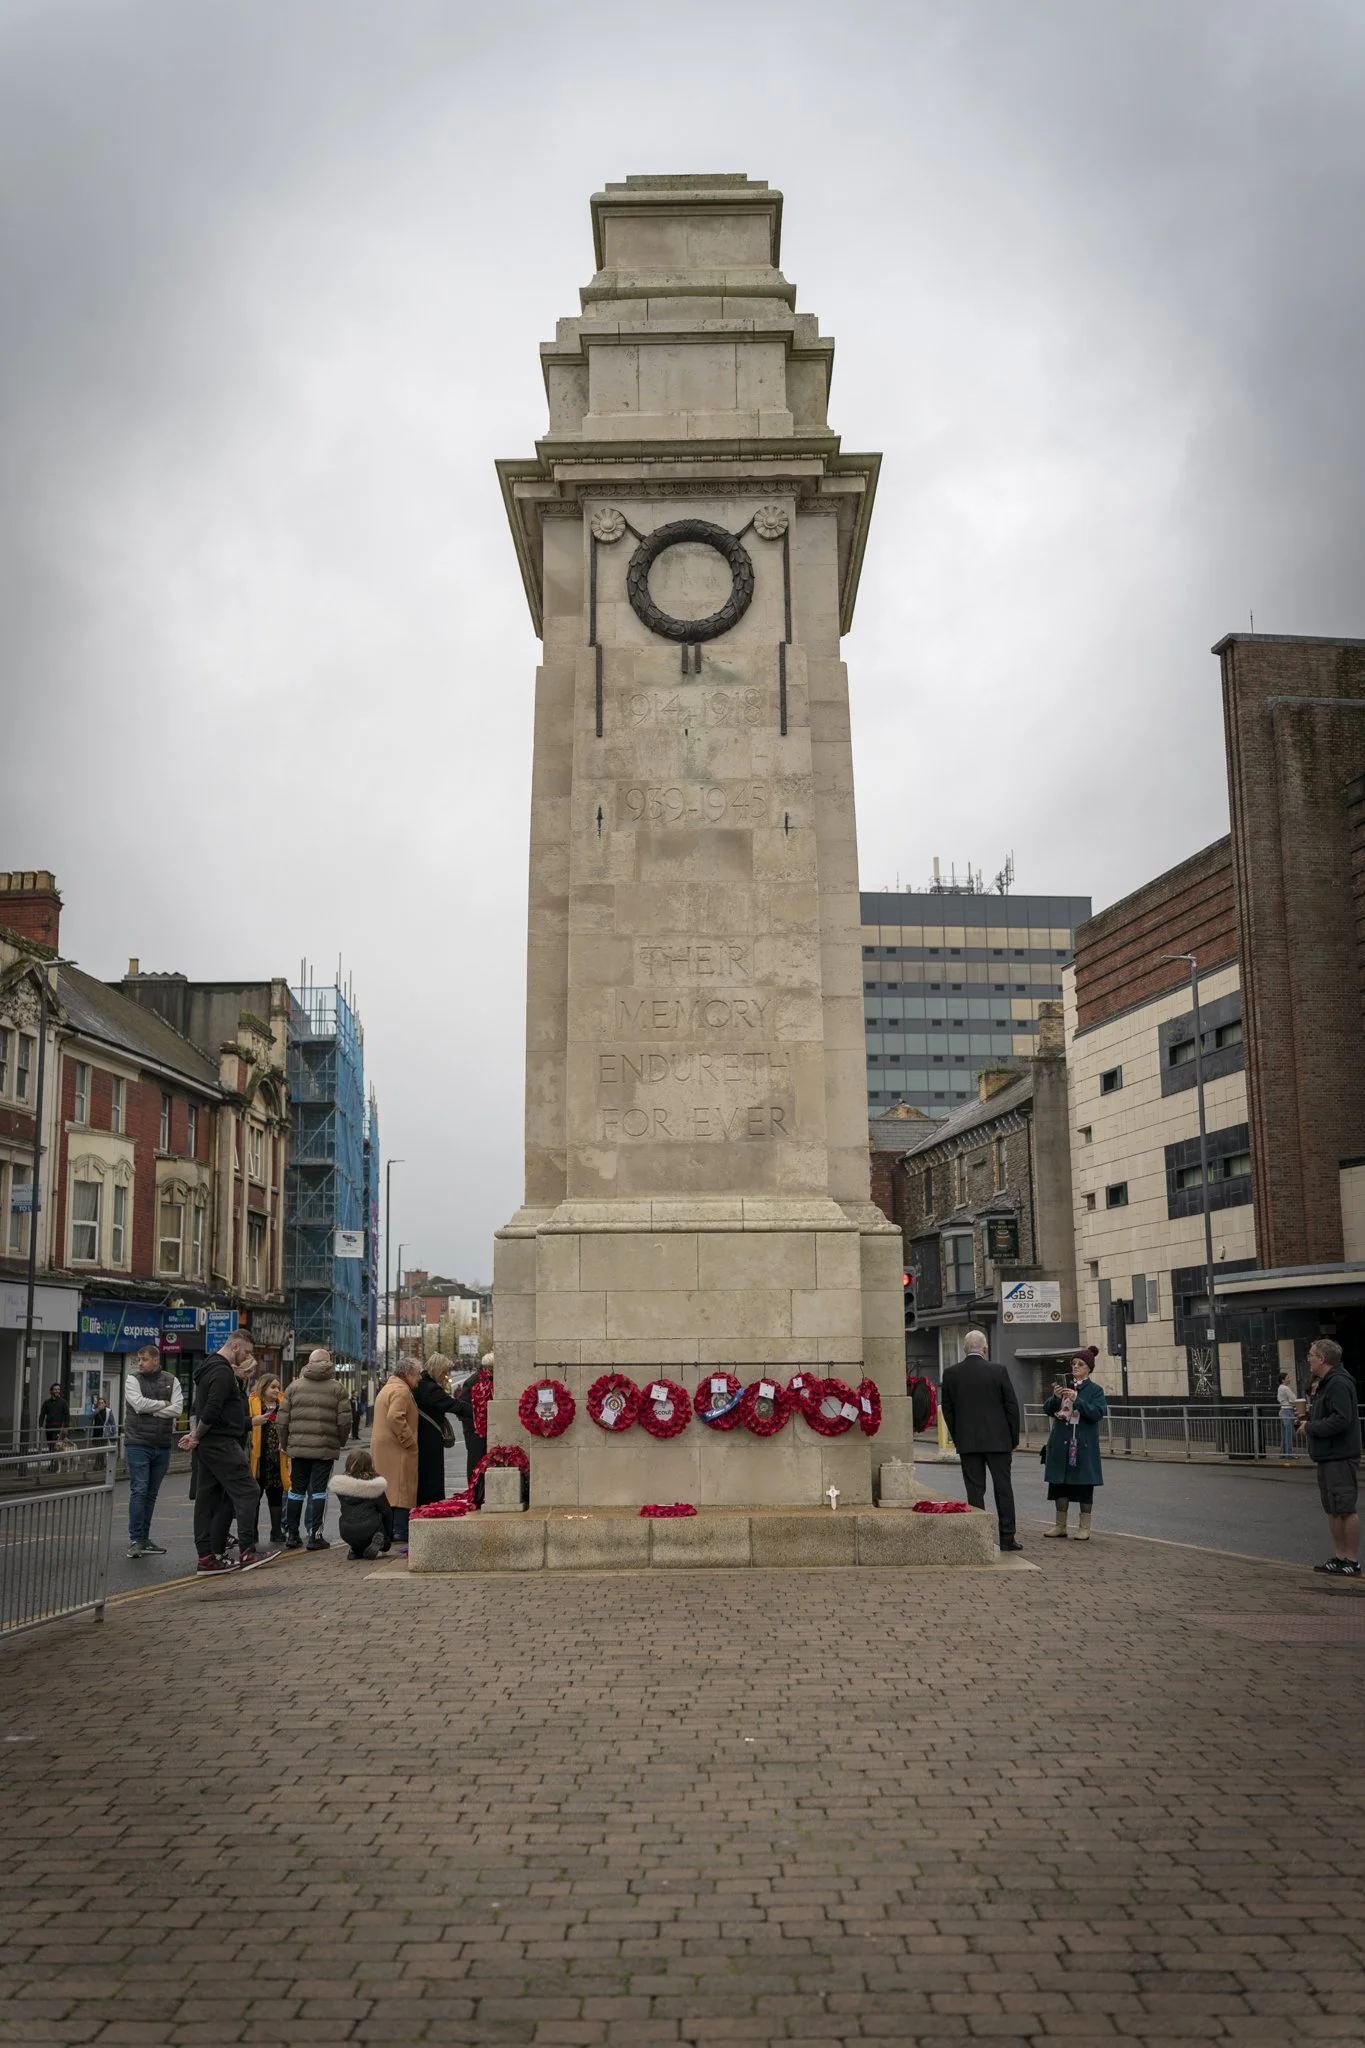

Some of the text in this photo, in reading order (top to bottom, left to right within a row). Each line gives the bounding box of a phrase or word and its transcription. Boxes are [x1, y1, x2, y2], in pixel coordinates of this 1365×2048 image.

[621, 688, 762, 728] 1914-1918
[618, 784, 769, 823] 1939-1945
[639, 946, 750, 976] THEIR
[616, 1000, 771, 1029] MEMORY
[599, 1052, 793, 1085] ENDURETH
[602, 1106, 790, 1140] FOR EVER
[1011, 1290, 1034, 1300] GBS
[90, 1316, 116, 1338] lifestyle
[124, 1324, 159, 1340] express
[164, 1323, 195, 1331] express
